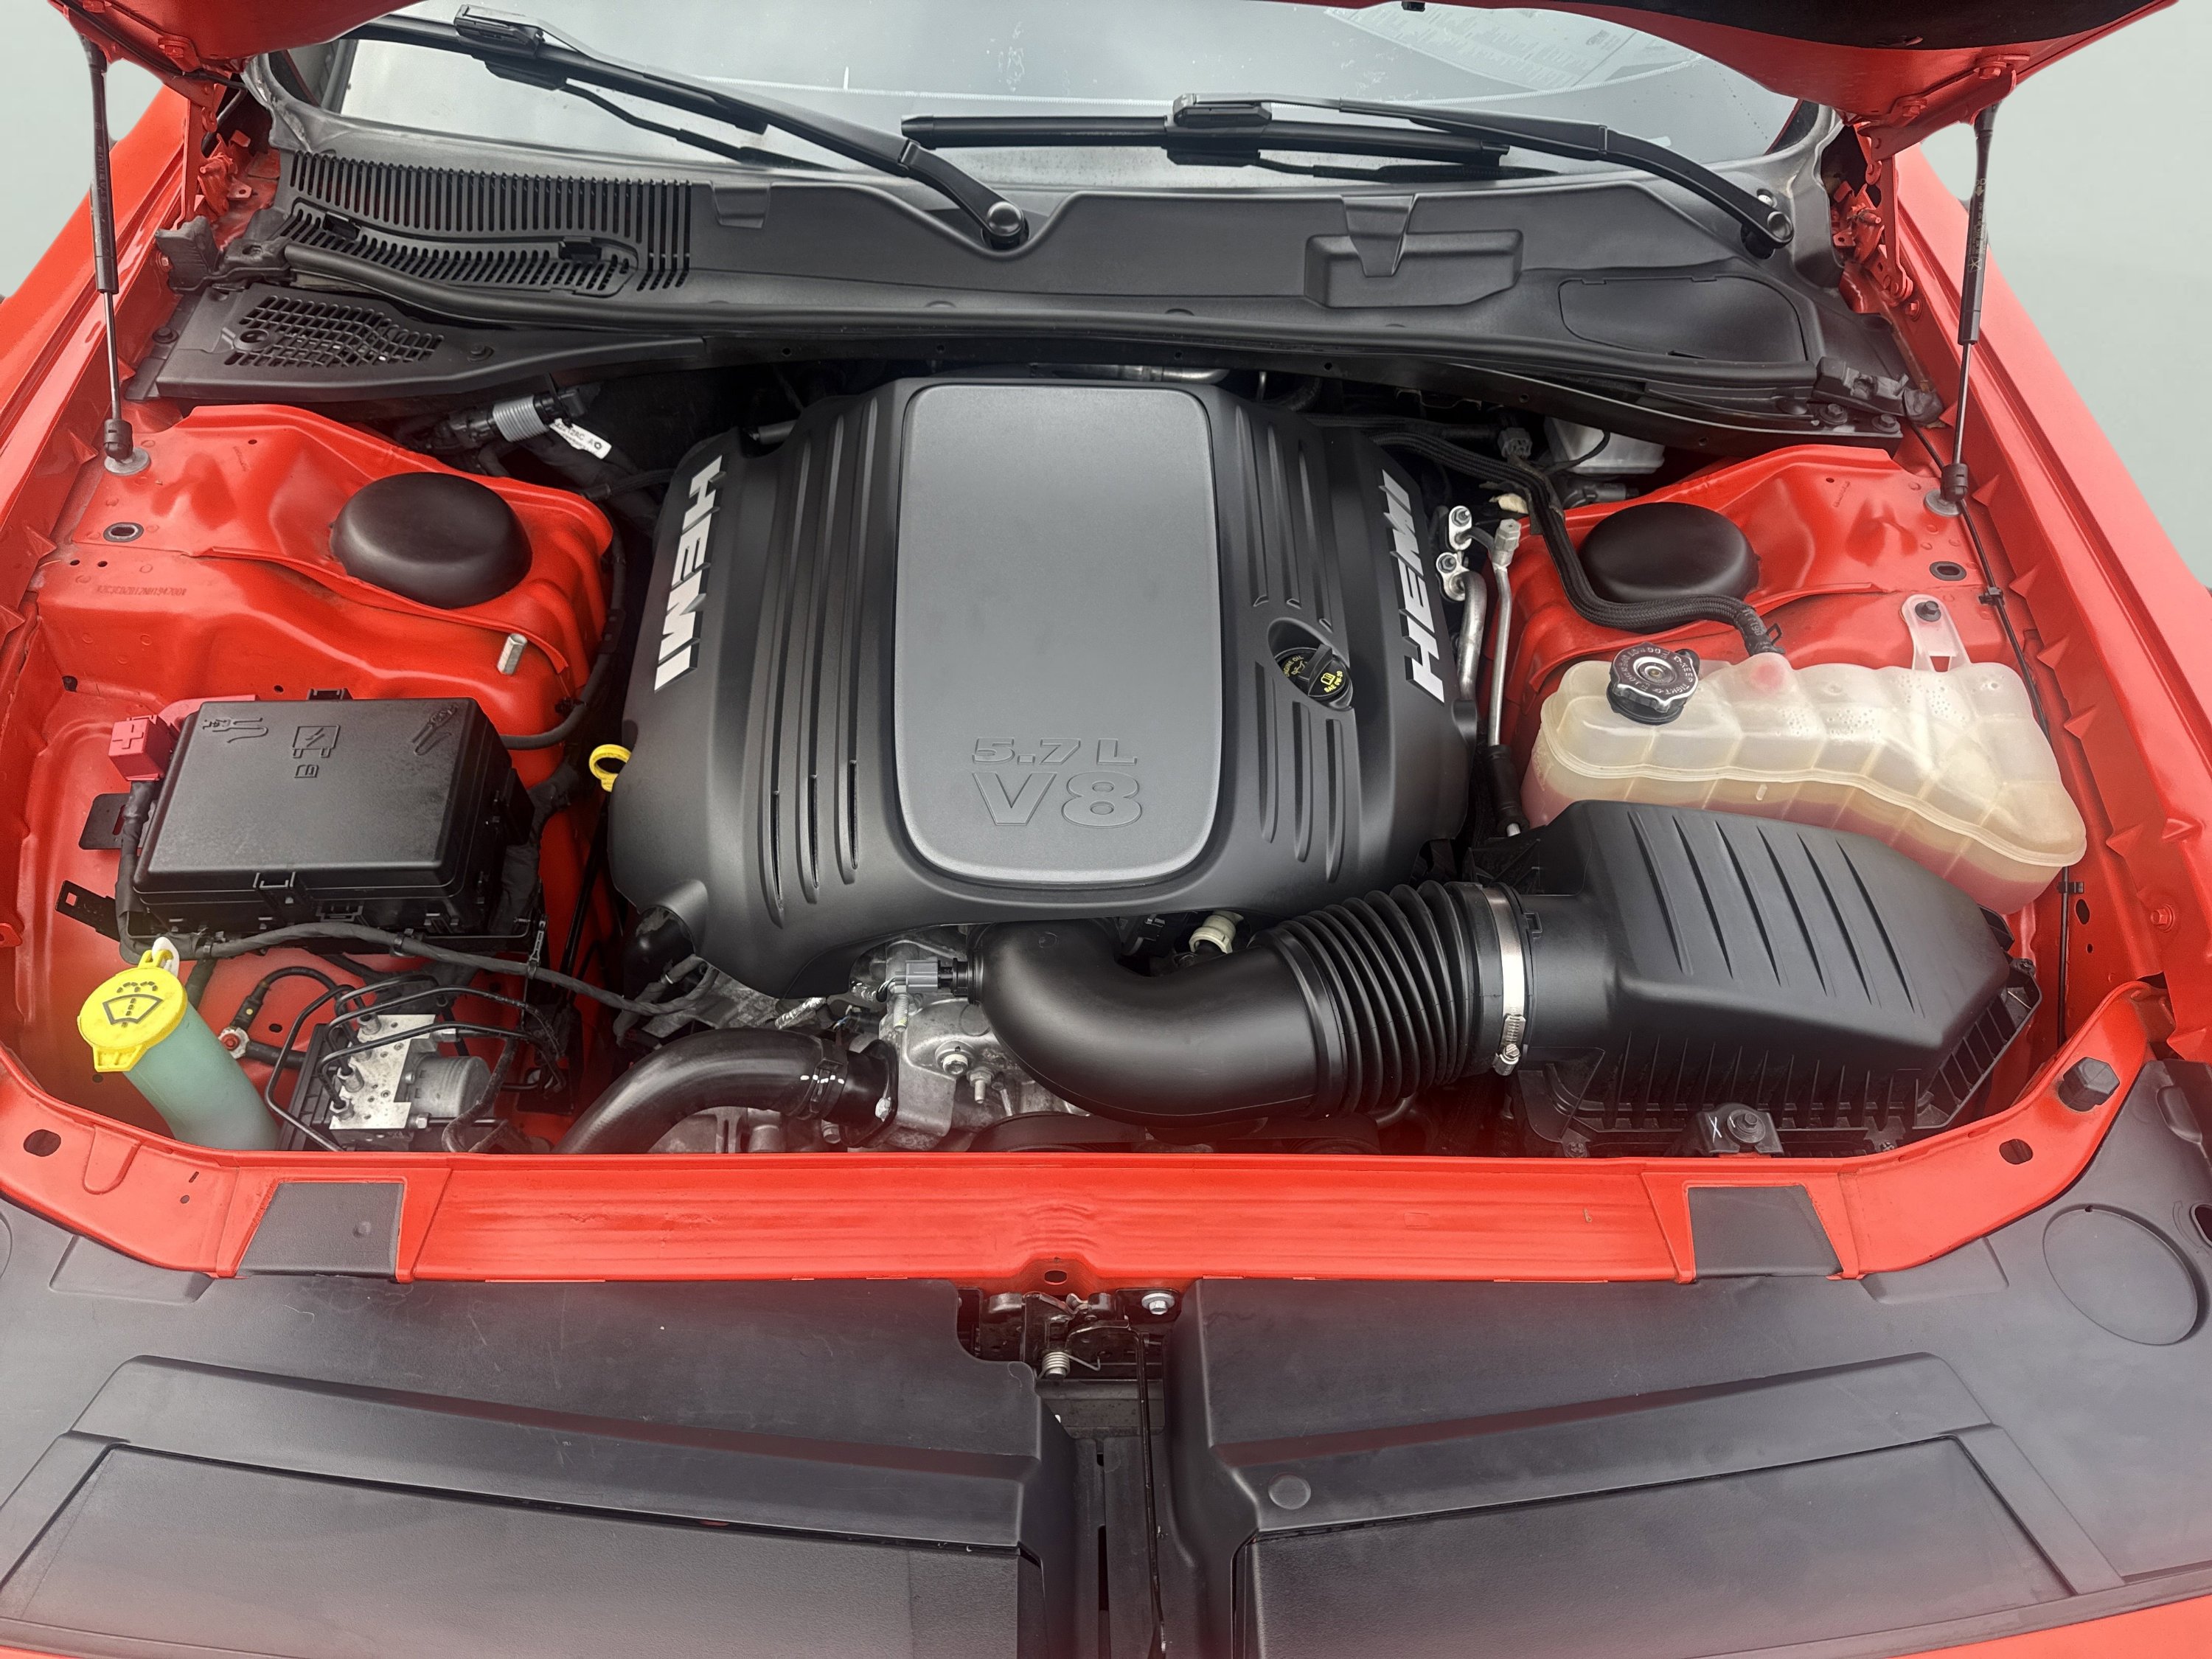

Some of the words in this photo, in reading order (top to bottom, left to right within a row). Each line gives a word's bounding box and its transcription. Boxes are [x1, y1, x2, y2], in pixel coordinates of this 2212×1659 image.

[654, 454, 723, 691] HEMI
[1381, 468, 1445, 704] HEMI
[1324, 684, 1337, 693] SAE
[1666, 683, 1690, 695] TIGHT
[971, 737, 1082, 765] 5.7
[1096, 738, 1138, 766] L
[971, 771, 1143, 830] V8
